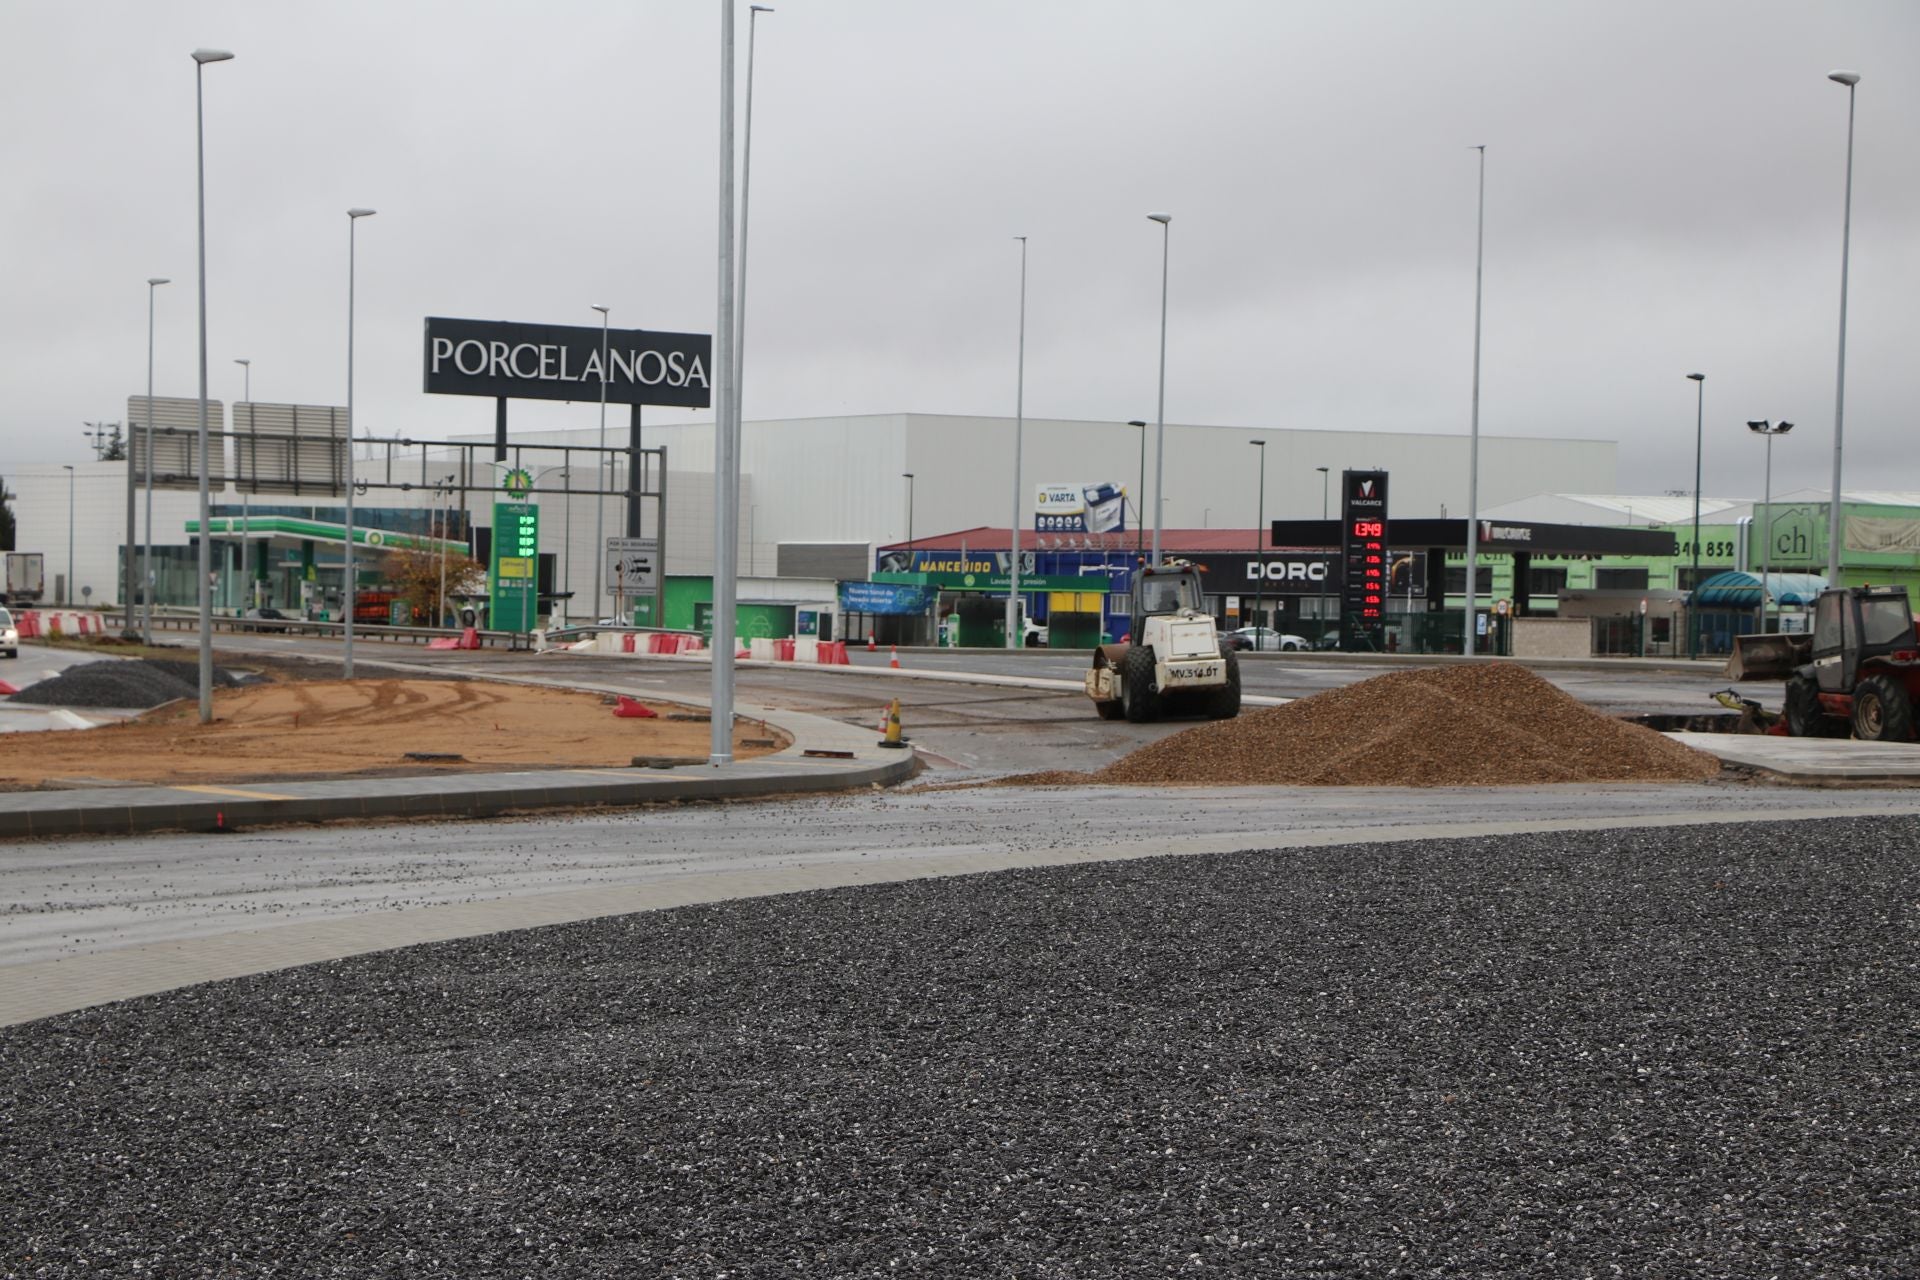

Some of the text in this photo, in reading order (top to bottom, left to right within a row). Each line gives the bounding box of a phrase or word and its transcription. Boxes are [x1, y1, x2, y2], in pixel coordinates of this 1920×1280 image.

[431, 337, 710, 388] PORCELANOSA
[1049, 493, 1076, 503] VARTA
[1706, 541, 1735, 557] 852
[1777, 525, 1807, 554] ch
[1247, 561, 1328, 581] DORO
